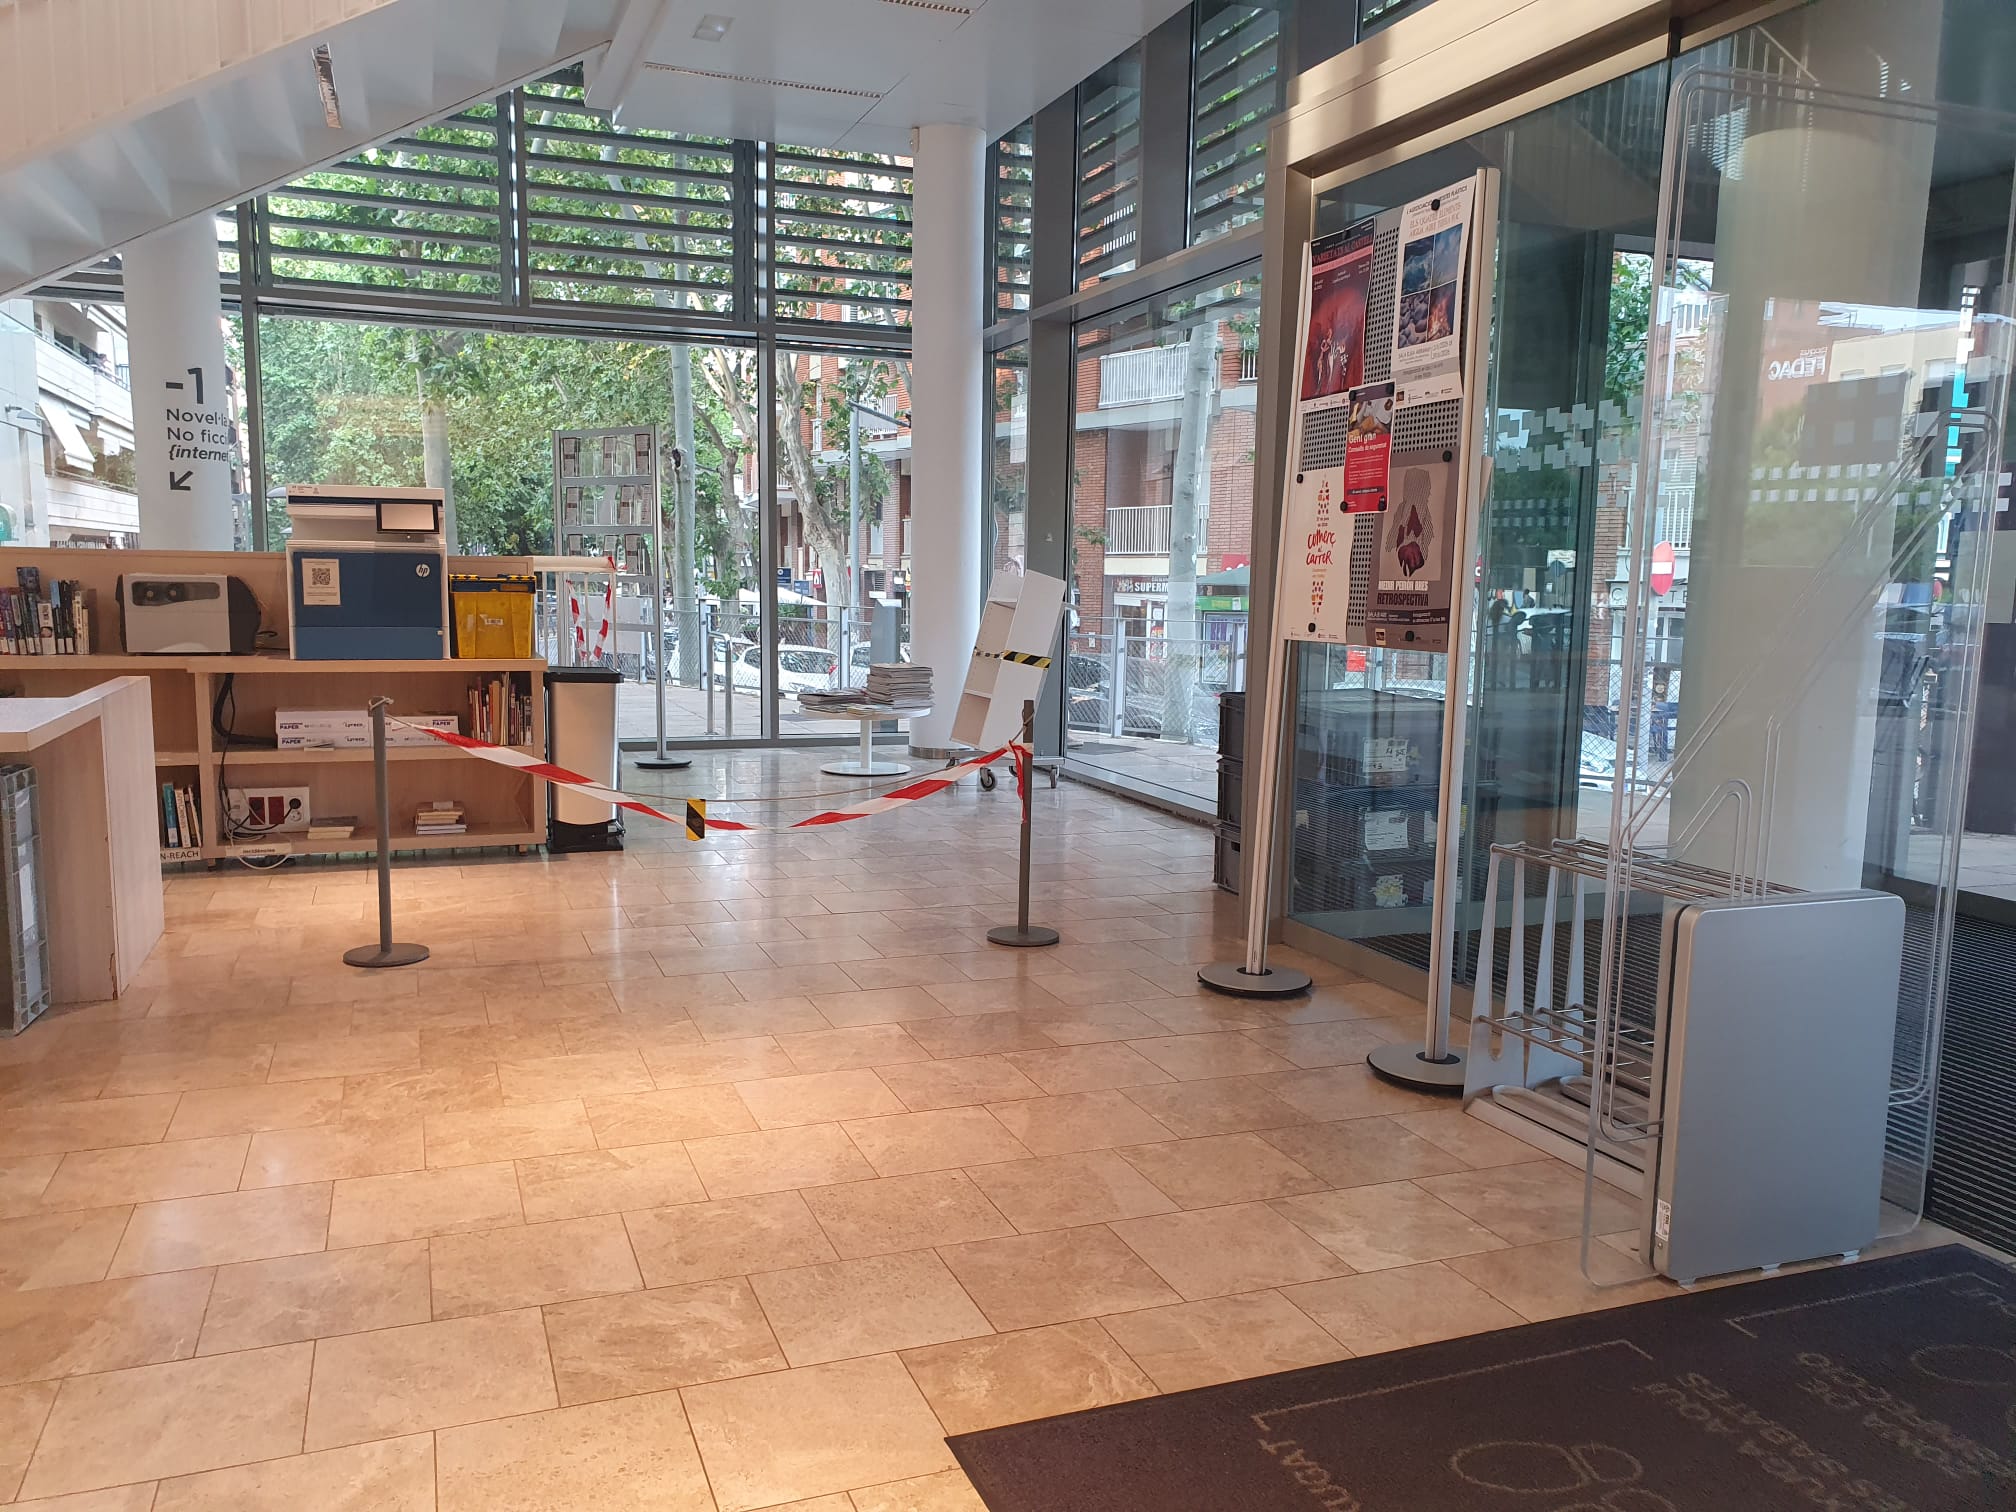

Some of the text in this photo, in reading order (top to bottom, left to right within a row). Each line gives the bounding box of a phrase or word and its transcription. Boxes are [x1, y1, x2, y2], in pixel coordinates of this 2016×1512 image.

[166, 367, 204, 405] -1
[167, 427, 194, 442] No
[417, 564, 429, 579] hp
[1377, 592, 1429, 606] RETROSPECTIVA
